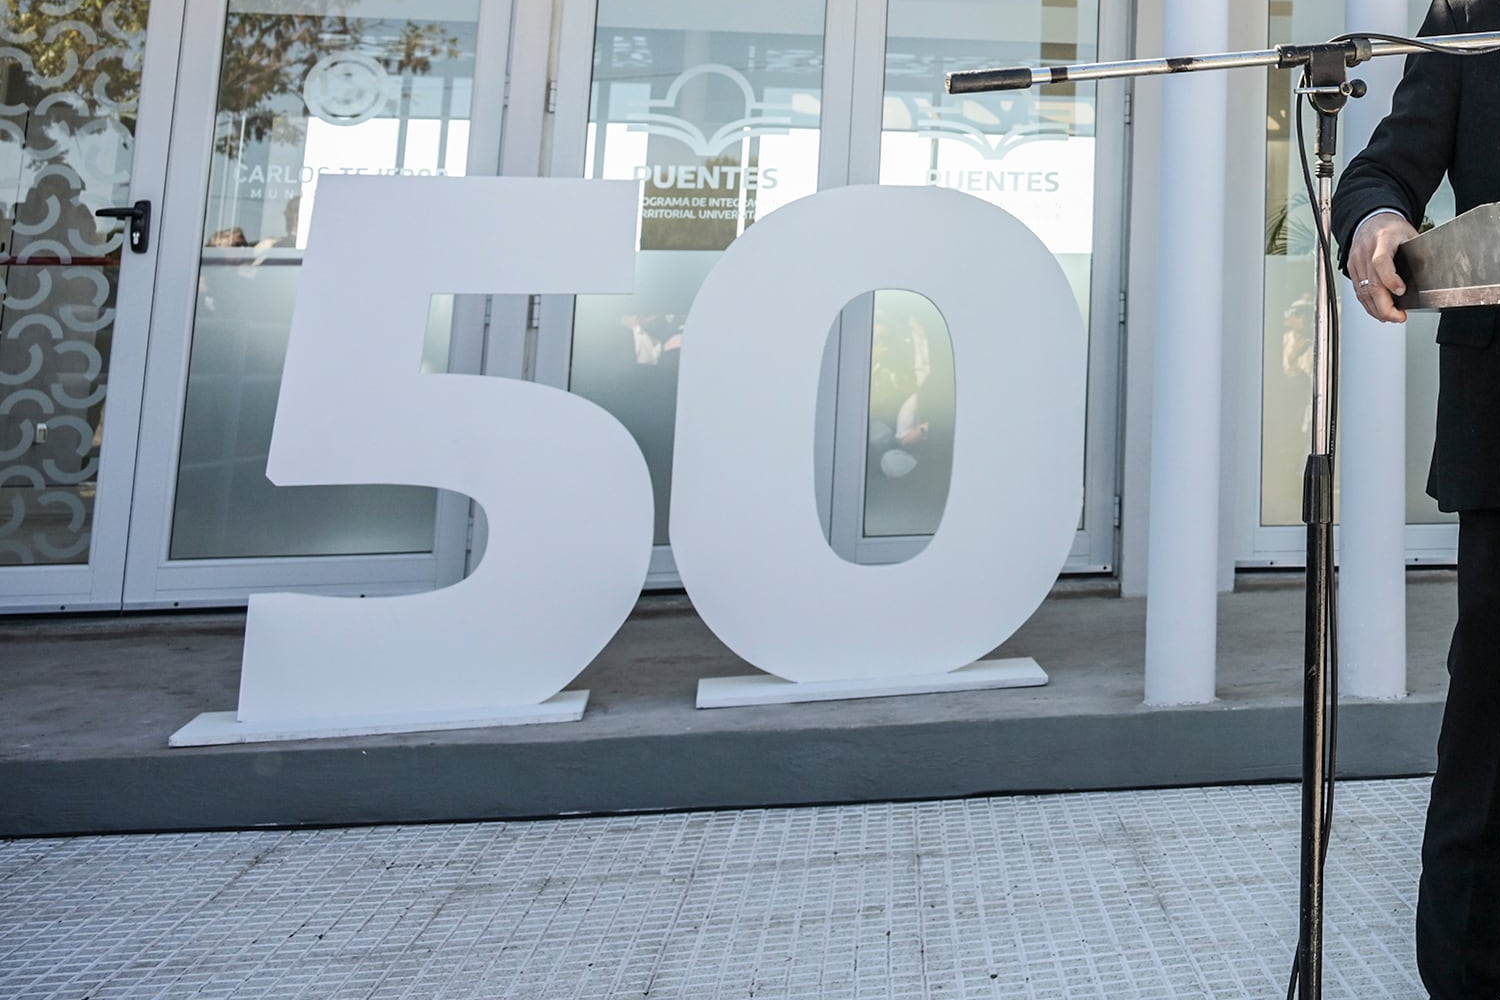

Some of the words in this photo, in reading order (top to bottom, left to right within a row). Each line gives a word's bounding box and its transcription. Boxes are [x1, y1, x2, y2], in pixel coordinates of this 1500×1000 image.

[633, 165, 778, 190] PUENTES
[926, 170, 1060, 192] PUENTES
[642, 197, 690, 207] OGRAMA
[692, 198, 706, 207] DE
[237, 173, 1085, 723] 50
